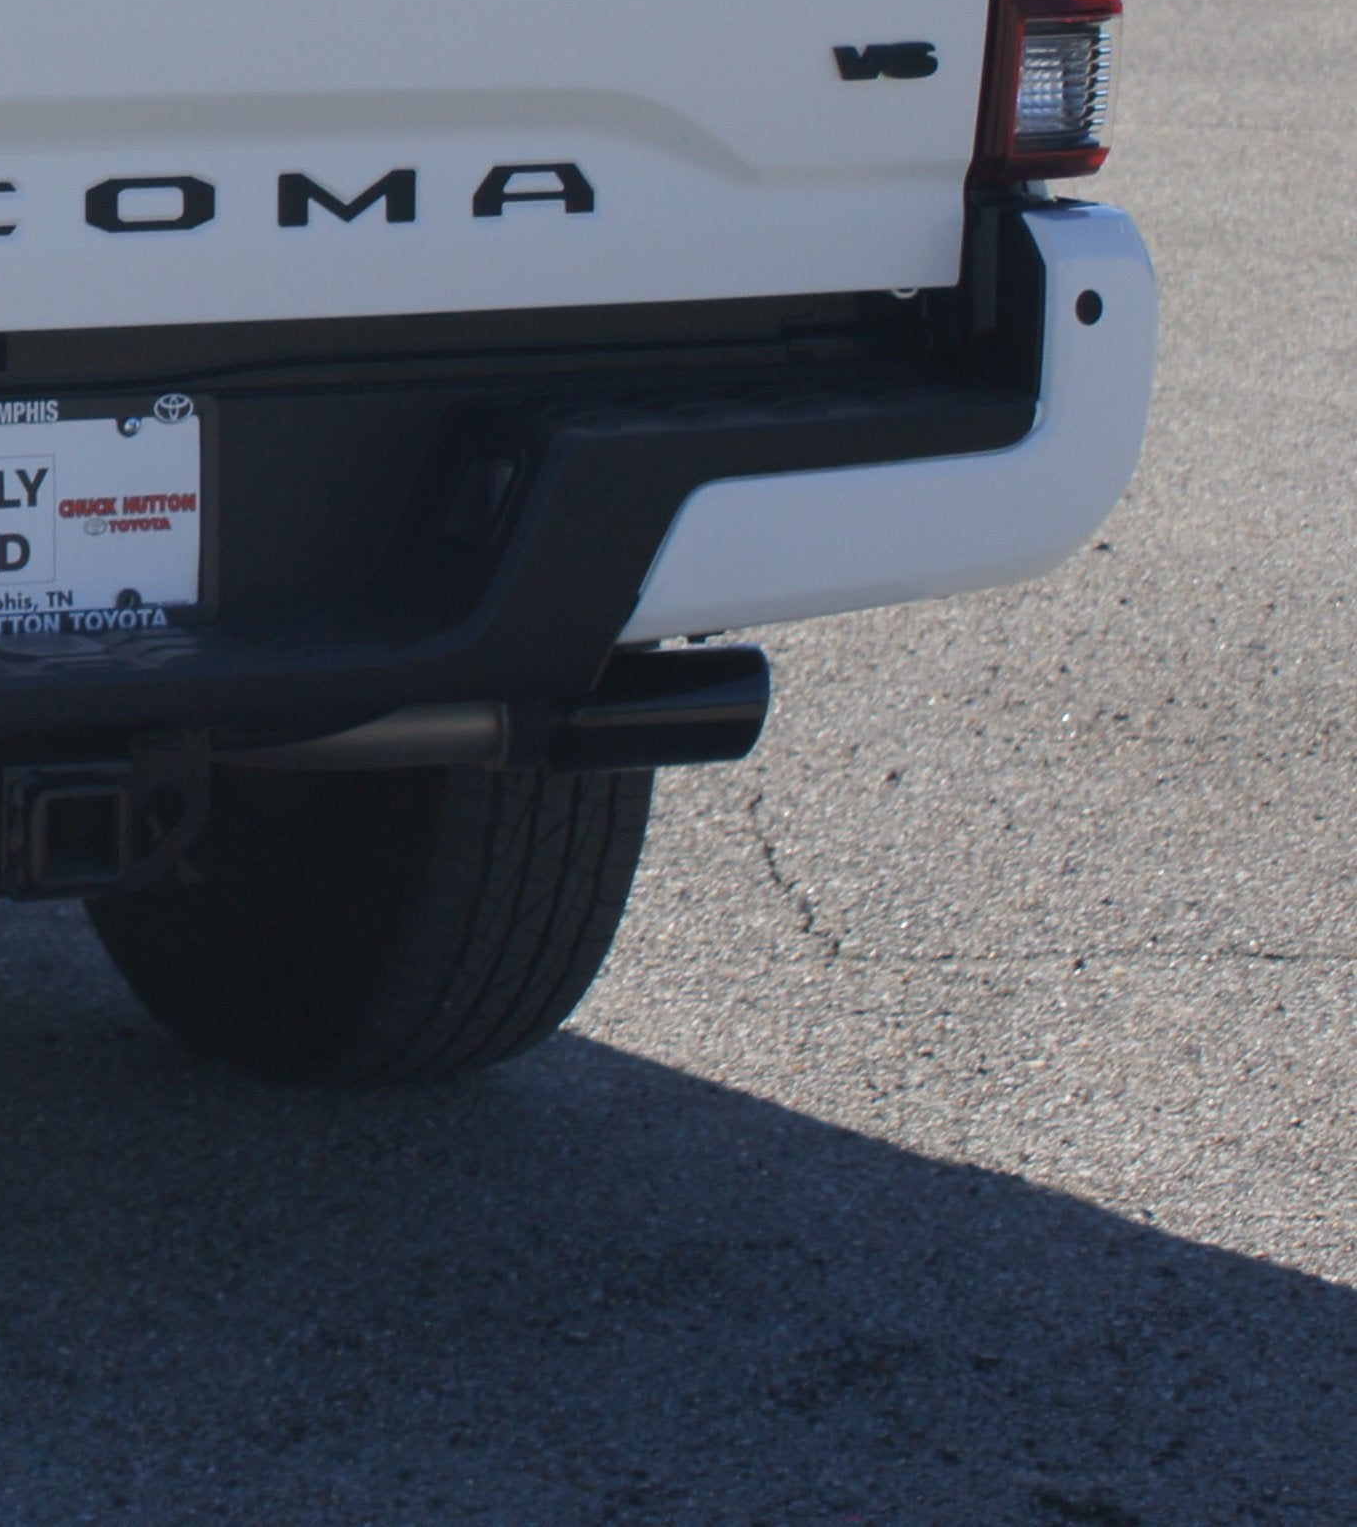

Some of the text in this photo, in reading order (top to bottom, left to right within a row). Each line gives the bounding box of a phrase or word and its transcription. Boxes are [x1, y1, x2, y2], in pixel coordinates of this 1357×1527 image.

[833, 41, 939, 81] V6
[58, 493, 197, 519] CHUCK HUTTON
[108, 517, 172, 533] TOYOTA
[45, 590, 74, 608] TN
[68, 607, 169, 633] TOYOTA
